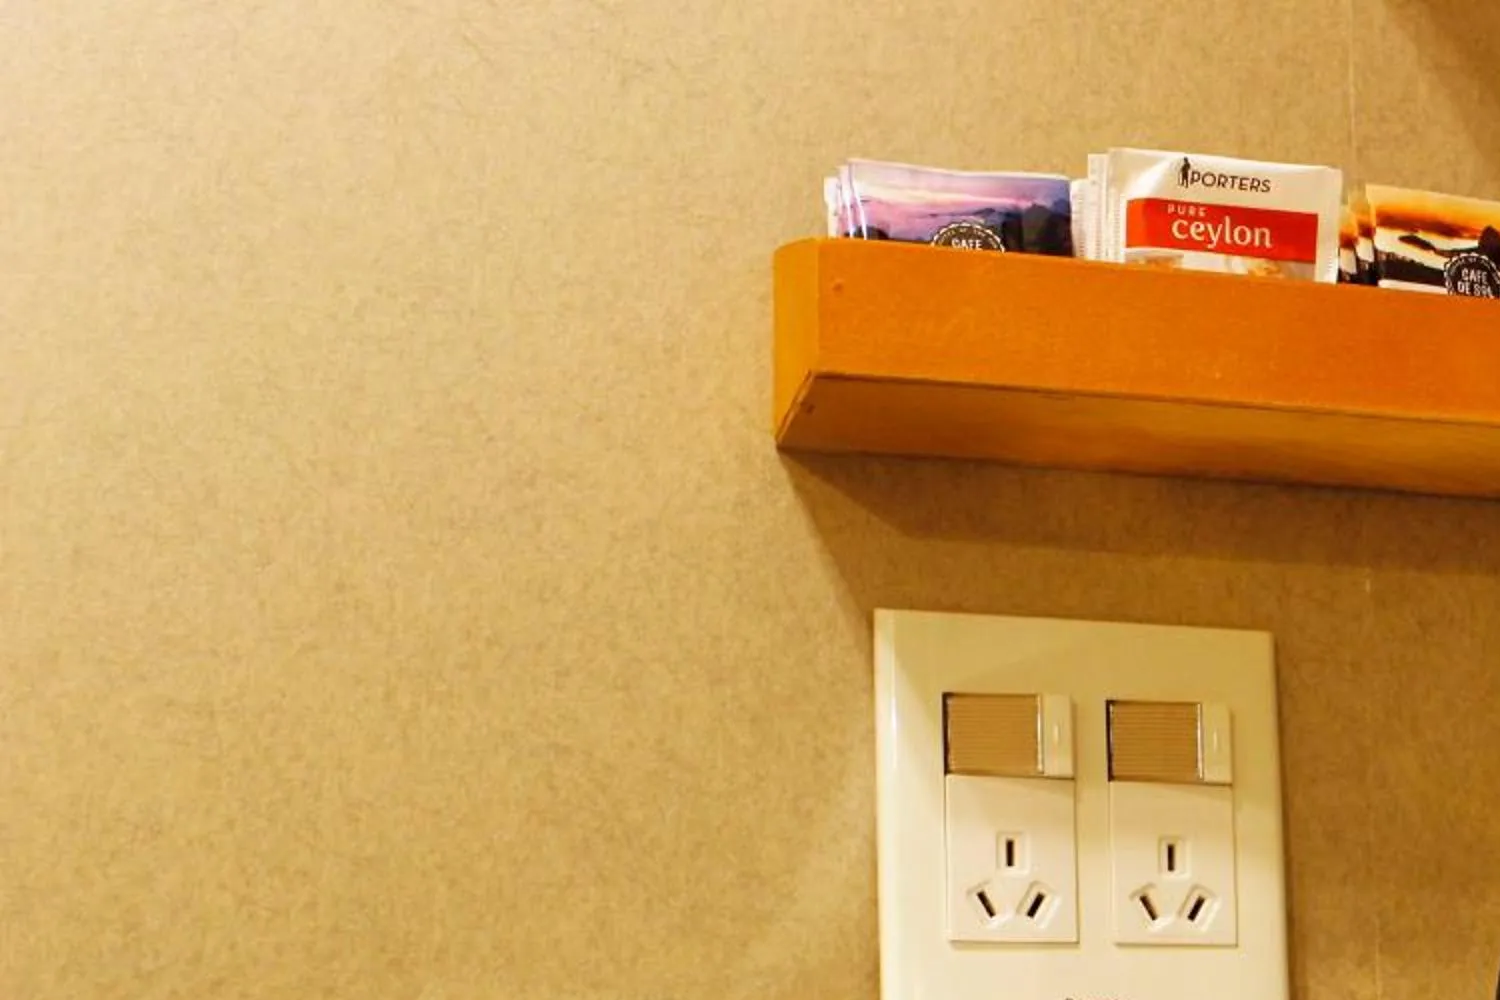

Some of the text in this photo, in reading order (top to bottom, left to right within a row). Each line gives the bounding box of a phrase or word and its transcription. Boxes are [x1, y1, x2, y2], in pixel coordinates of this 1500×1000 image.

[1190, 170, 1271, 193] PORTERS
[1167, 203, 1207, 217] PURE
[1171, 215, 1273, 249] ceylon
[1461, 268, 1488, 285] CAFE
[1457, 281, 1472, 296] DE
